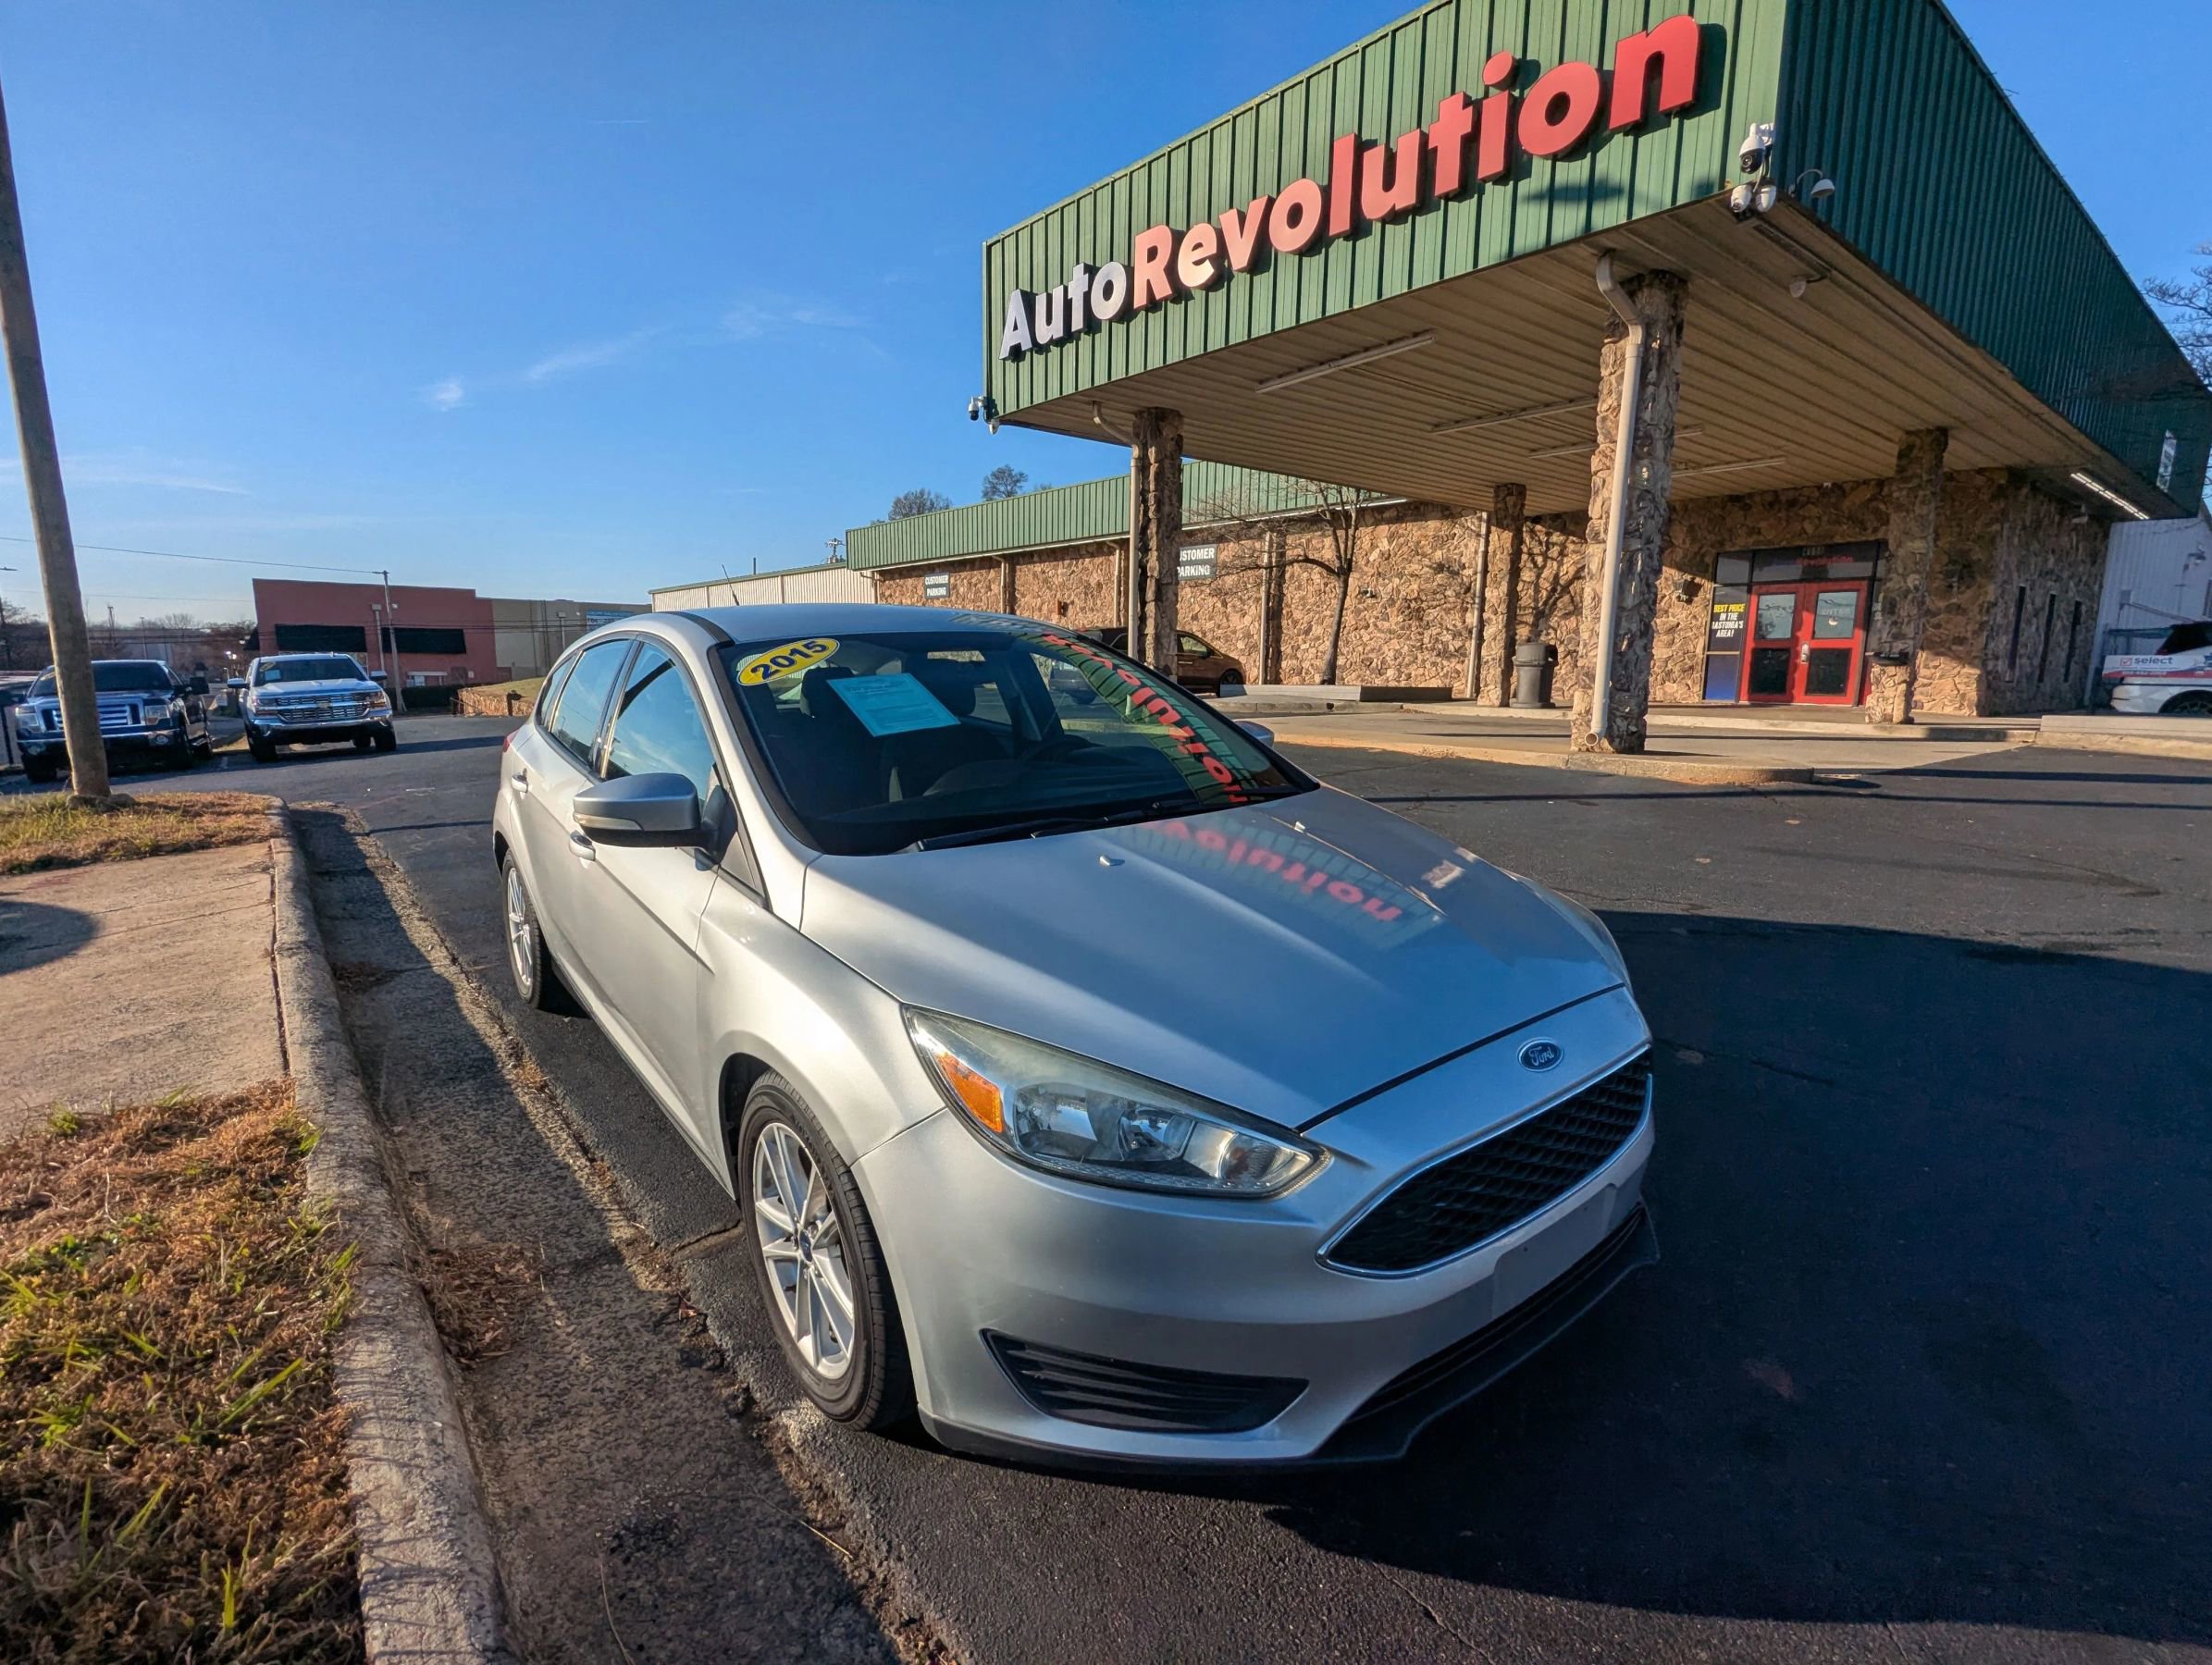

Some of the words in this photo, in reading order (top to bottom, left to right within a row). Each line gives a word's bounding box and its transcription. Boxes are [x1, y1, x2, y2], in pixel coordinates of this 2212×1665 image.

[999, 14, 1701, 360] AutoRevolution
[925, 574, 948, 585] CUSTOMER
[926, 586, 946, 597] PARKING
[1713, 604, 1729, 612] BEST
[1728, 603, 1746, 612] PRICE
[1719, 612, 1727, 621] IN
[1727, 612, 1739, 621] THE
[1715, 629, 1735, 638] AREA!
[750, 640, 828, 680] 2015
[2133, 656, 2174, 665] select
[1527, 1045, 1555, 1067] Ford
